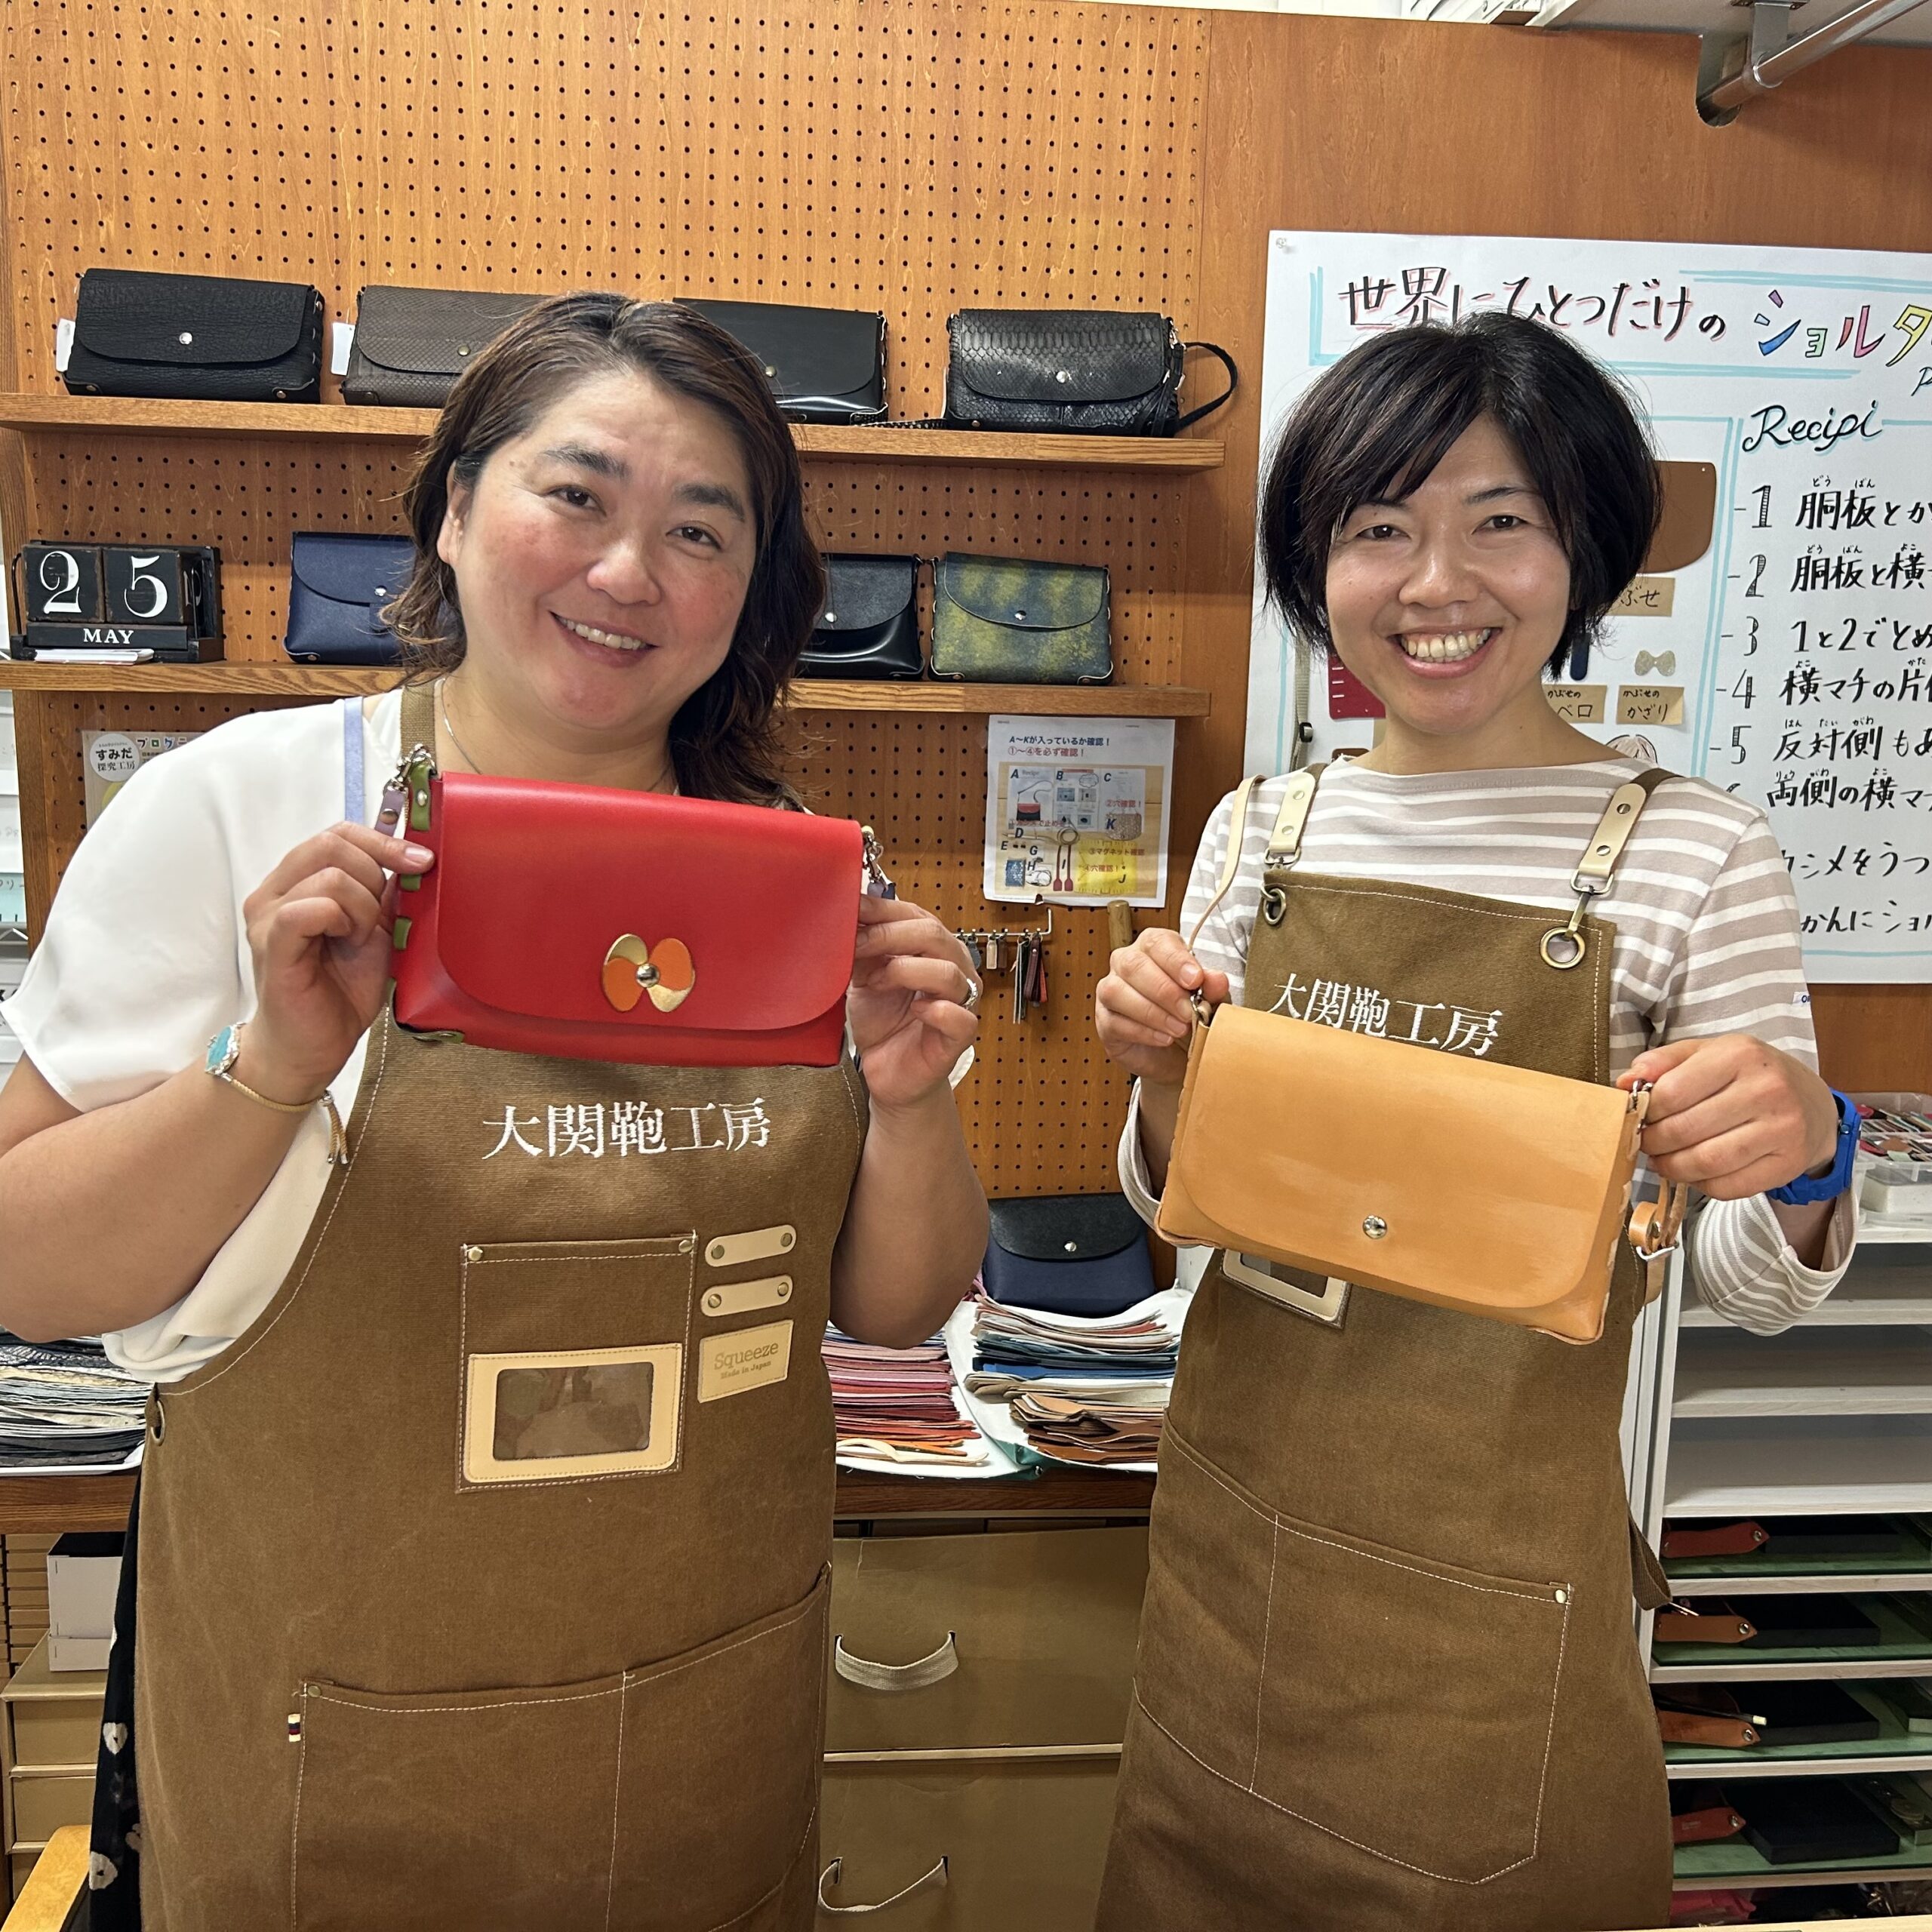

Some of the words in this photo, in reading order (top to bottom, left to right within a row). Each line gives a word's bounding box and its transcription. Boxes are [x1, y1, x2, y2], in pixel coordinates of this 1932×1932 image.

[1742, 400, 1883, 452] Recipi
[1813, 475, 1832, 487] どう
[1855, 478, 1875, 488] ばん
[1807, 544, 1823, 554] どう
[1842, 545, 1863, 554] ばん
[1790, 552, 1932, 592] 胴板と横
[83, 628, 134, 645] MAY
[1627, 703, 1668, 722] かざり
[96, 747, 133, 761] すみだ
[1011, 769, 1019, 779] A
[1057, 771, 1063, 780] B
[1104, 773, 1112, 782] C
[1106, 818, 1116, 829] K
[1015, 828, 1023, 838] D
[1001, 841, 1008, 850] E
[1030, 845, 1038, 855] G
[1027, 861, 1036, 871] H
[1118, 874, 1126, 883] J
[1267, 973, 1503, 1056] 大関鞄工房
[482, 1098, 771, 1159] 大関鞄工房
[714, 1343, 779, 1370] Squeeze
[721, 1367, 740, 1380] Made
[751, 1361, 771, 1371] Japan
